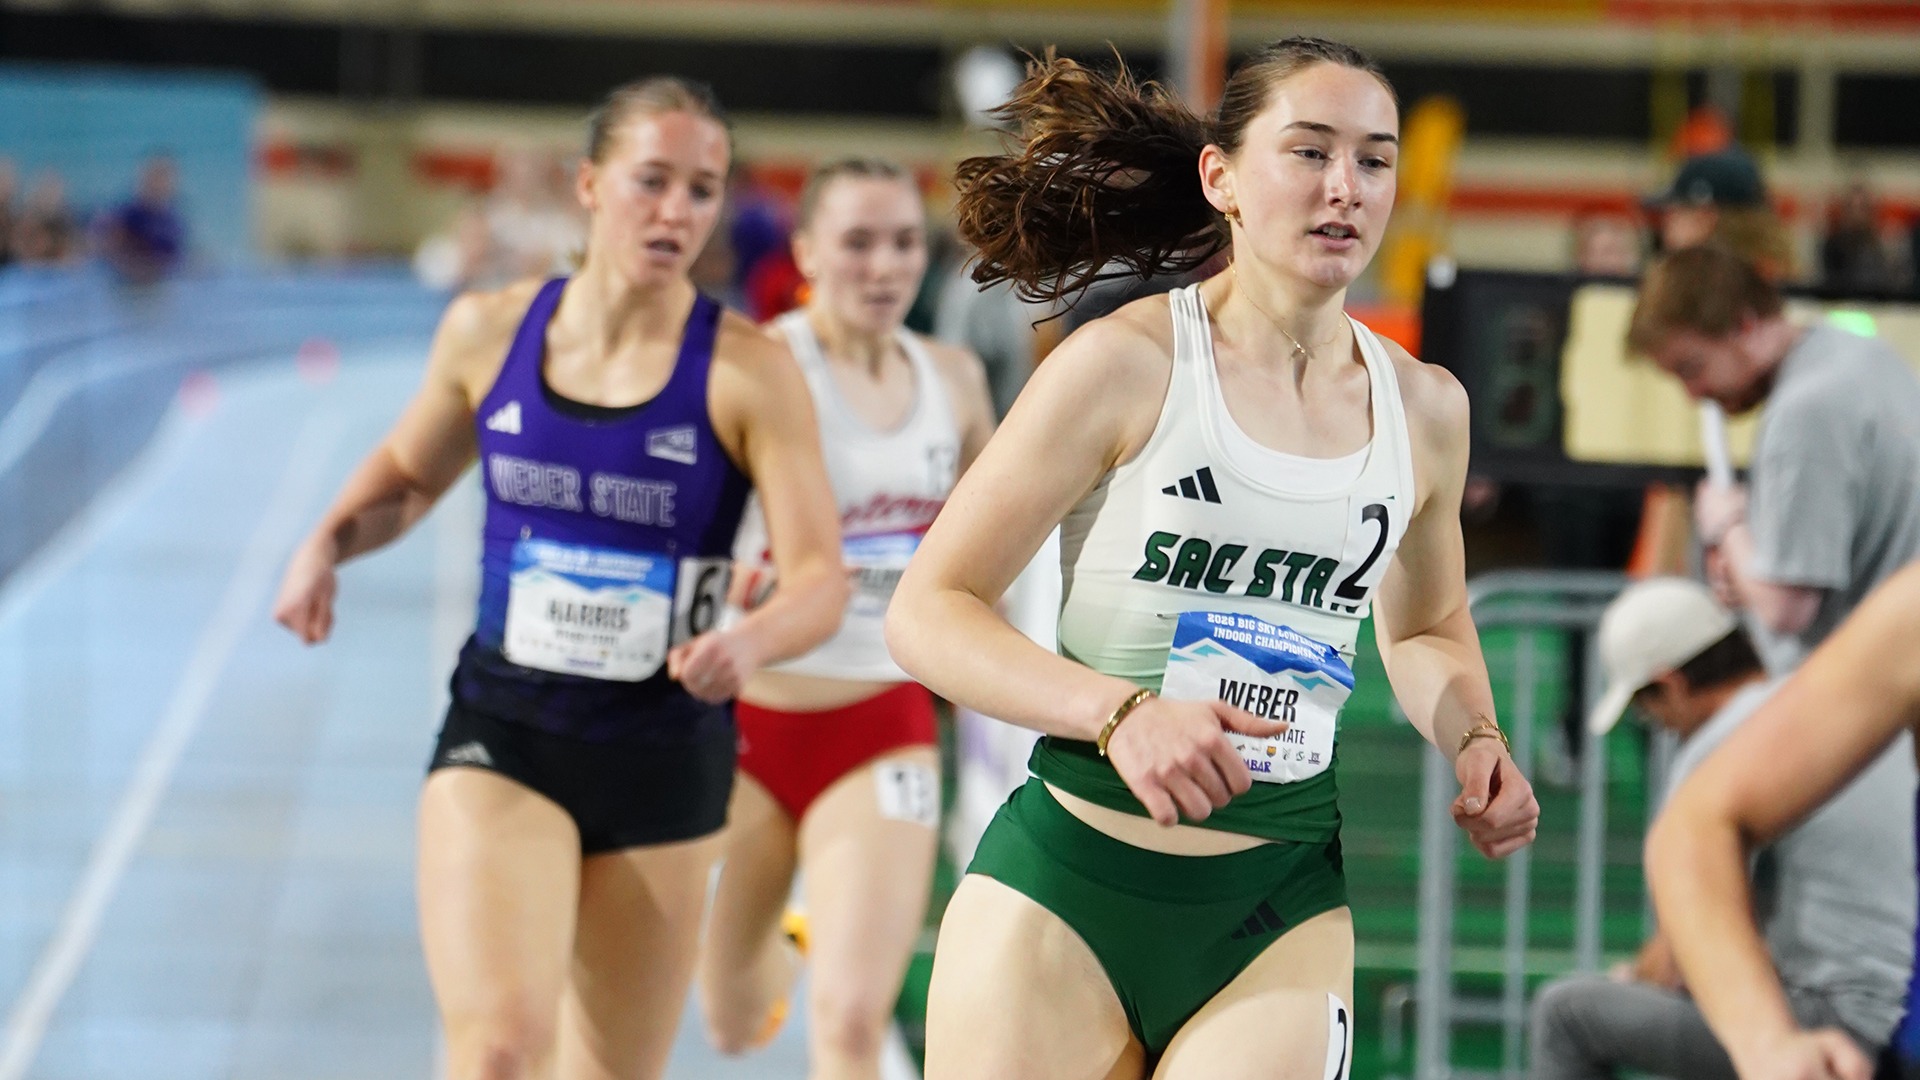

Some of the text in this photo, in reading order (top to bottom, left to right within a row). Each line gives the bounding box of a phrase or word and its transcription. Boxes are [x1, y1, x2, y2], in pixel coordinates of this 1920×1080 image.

[488, 452, 678, 528] WEBER STATE
[1132, 530, 1360, 614] SAC STA
[1334, 503, 1390, 600] 2
[548, 600, 631, 632] HARRIS
[689, 566, 718, 637] 6
[1206, 612, 1236, 627] 2026
[1237, 617, 1256, 631] BIG
[1257, 620, 1277, 635] SKY
[1213, 626, 1253, 645] INDOOR
[1218, 678, 1299, 723] WEBER
